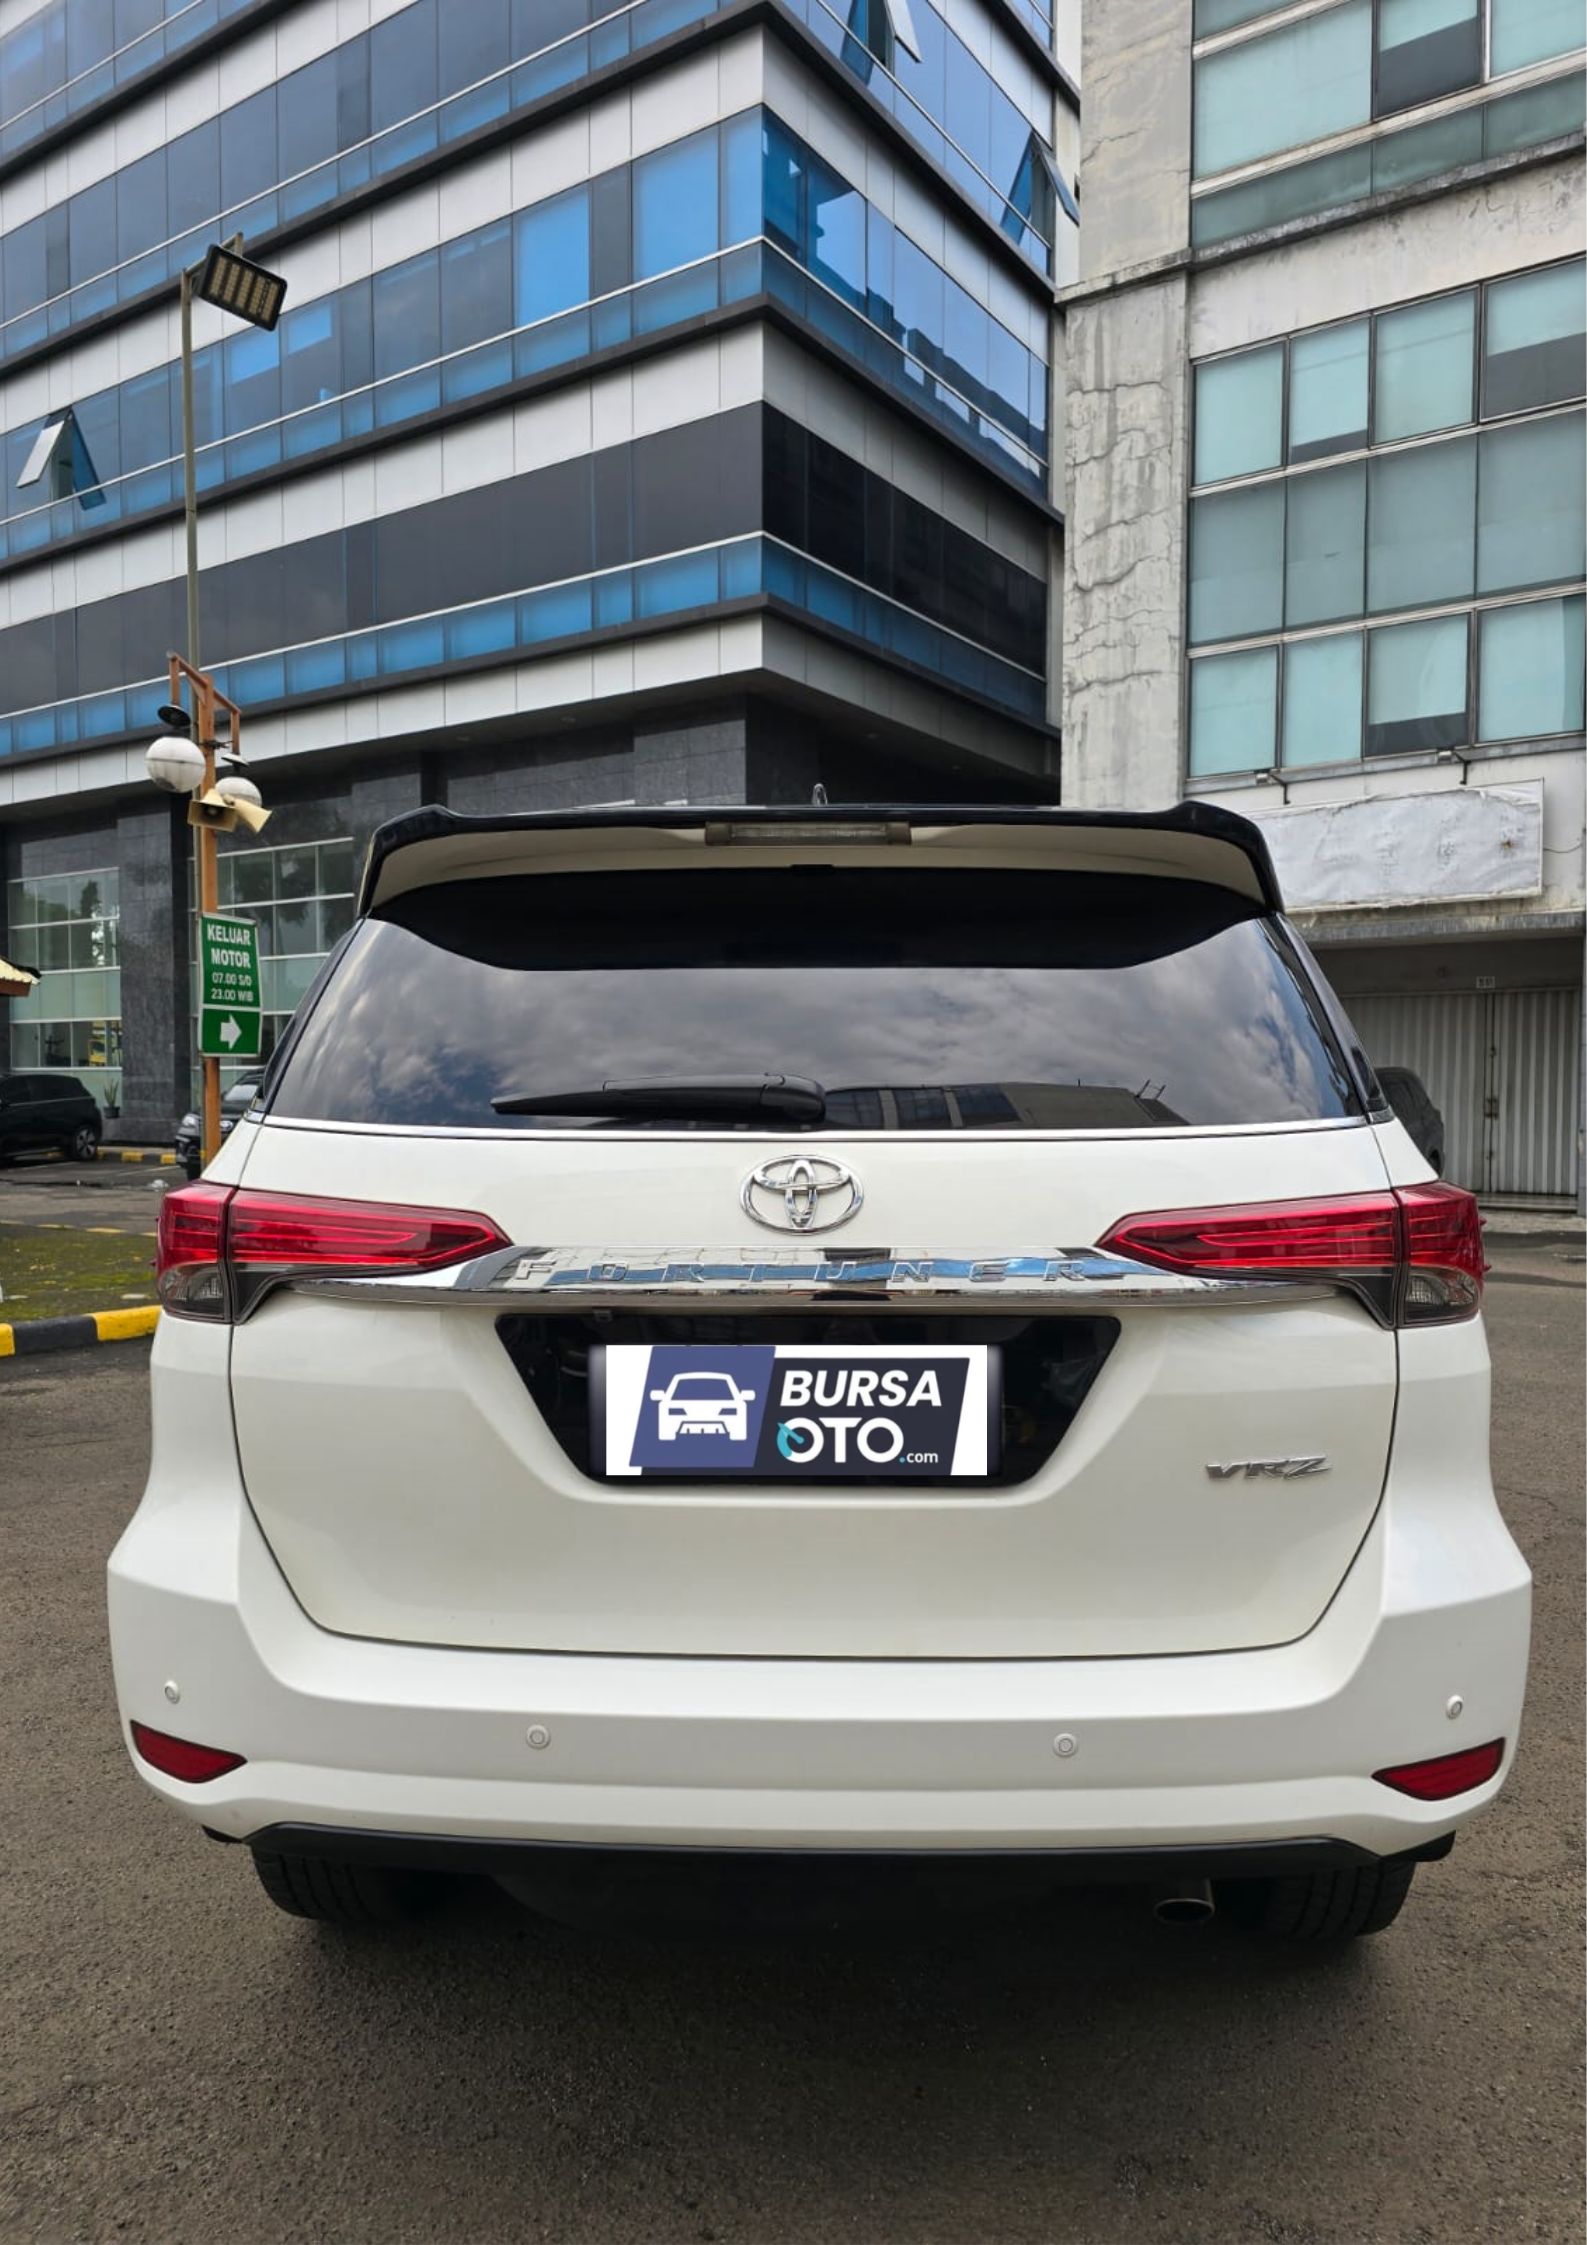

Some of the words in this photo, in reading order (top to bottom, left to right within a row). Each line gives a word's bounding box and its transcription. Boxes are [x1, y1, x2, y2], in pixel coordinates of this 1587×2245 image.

[207, 924, 251, 946] KELUAR
[211, 948, 251, 968] MOTOR
[212, 972, 237, 984] 07.00
[211, 988, 236, 1000] 23.00
[514, 1259, 1086, 1284] FORTUNER
[1205, 1455, 1332, 1480] VRZ
